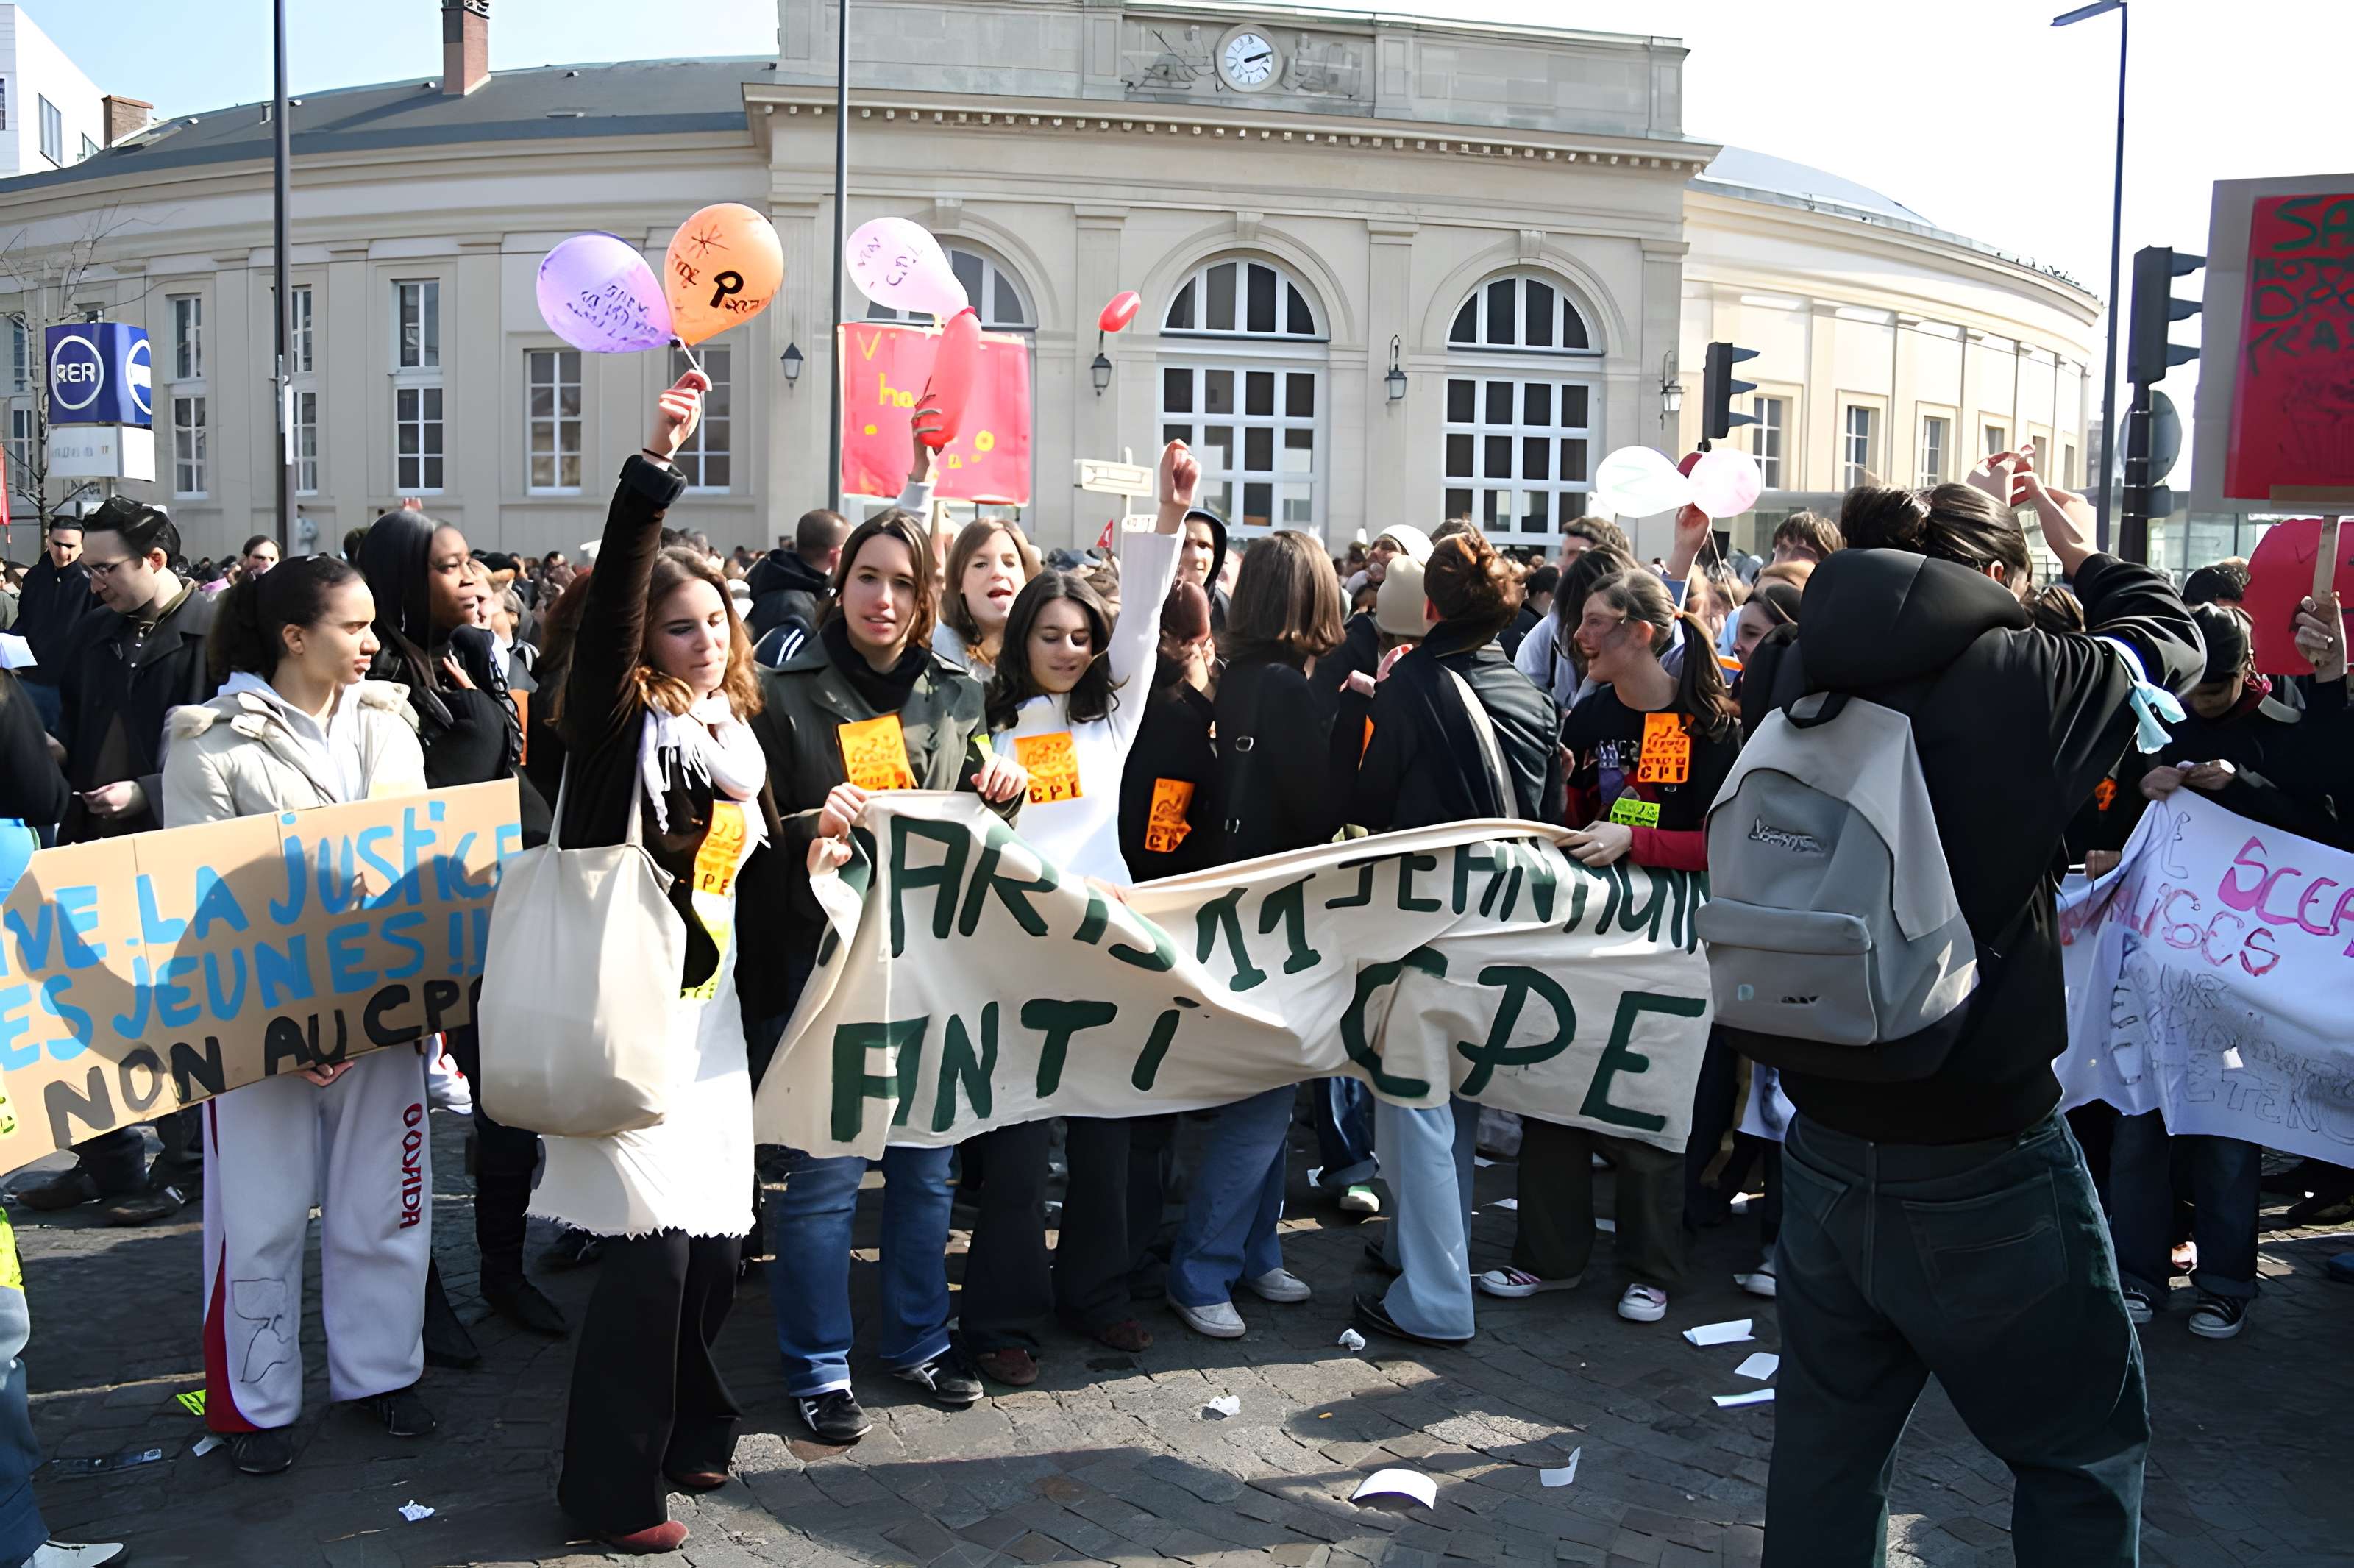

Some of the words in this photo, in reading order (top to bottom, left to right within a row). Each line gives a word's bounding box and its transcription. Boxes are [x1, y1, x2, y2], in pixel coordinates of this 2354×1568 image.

[57, 362, 96, 383] RER
[136, 865, 249, 944] LA
[44, 1036, 226, 1149] NON
[264, 1008, 347, 1075] AU
[1340, 945, 1706, 1132] CPE
